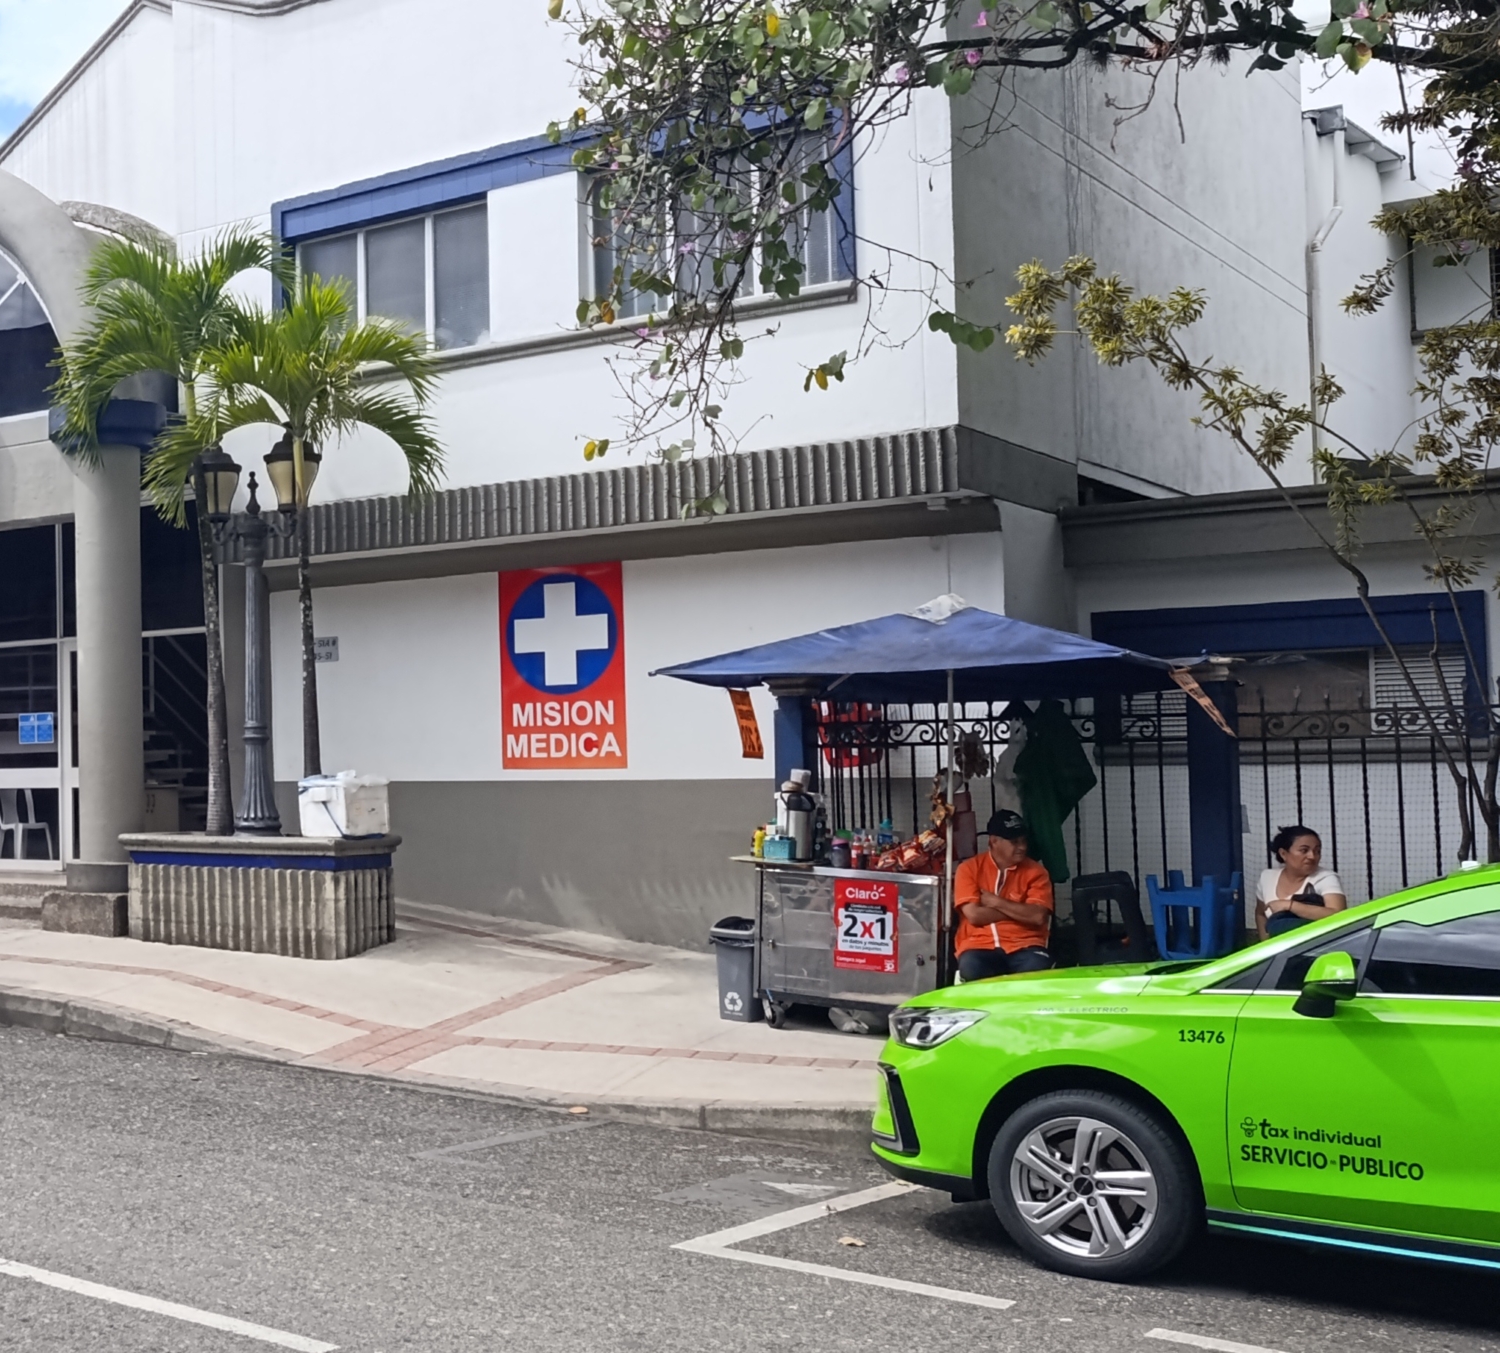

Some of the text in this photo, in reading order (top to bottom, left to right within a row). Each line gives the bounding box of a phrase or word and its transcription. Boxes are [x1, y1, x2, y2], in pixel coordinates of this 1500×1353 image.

[512, 699, 614, 727] MISION
[506, 732, 622, 758] MEDICA
[845, 887, 880, 900] Claro
[843, 914, 886, 940] 2x1
[1178, 1029, 1226, 1044] 13476
[1259, 1118, 1382, 1148] tax individual
[1240, 1144, 1425, 1181] SERVICIO PUBLICO
